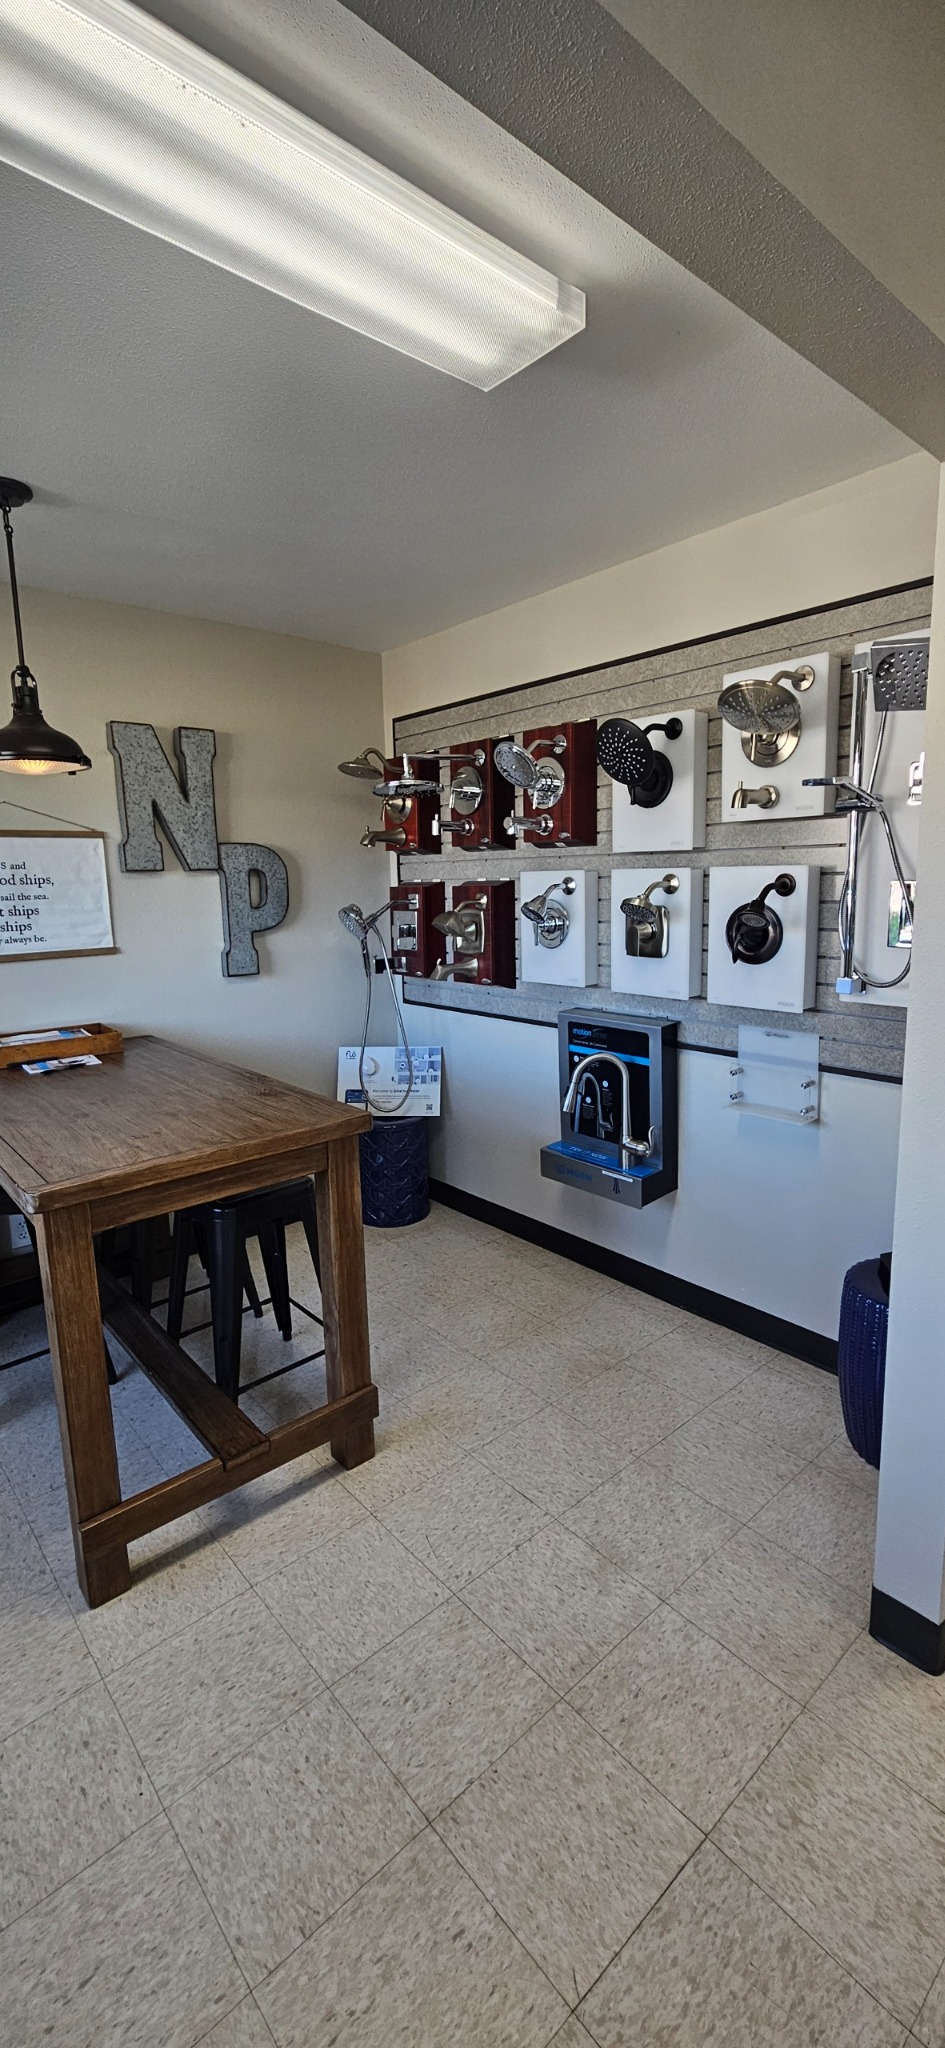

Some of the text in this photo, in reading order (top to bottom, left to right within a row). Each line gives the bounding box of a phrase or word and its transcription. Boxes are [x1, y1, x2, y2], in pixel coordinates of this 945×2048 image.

[107, 721, 289, 977] N P
[10, 862, 26, 870] and
[19, 874, 54, 888] ships,
[0, 893, 15, 901] sail
[18, 893, 31, 901] the
[8, 906, 39, 919] ships
[5, 936, 32, 945] always
